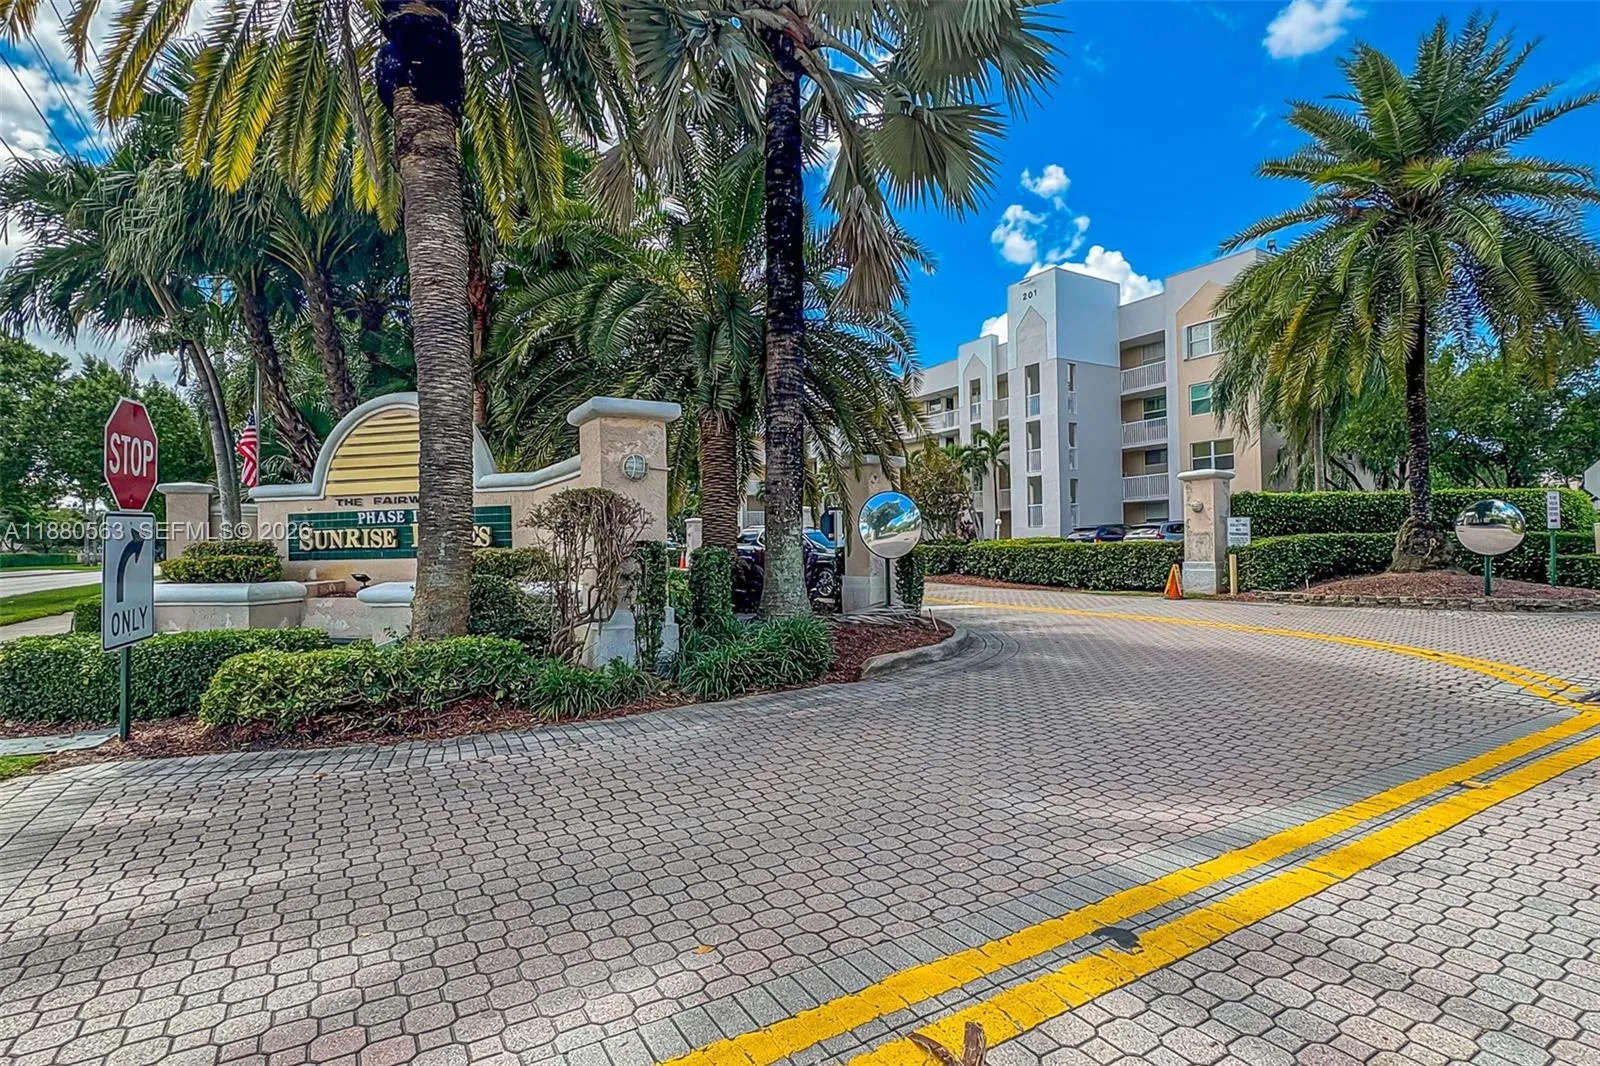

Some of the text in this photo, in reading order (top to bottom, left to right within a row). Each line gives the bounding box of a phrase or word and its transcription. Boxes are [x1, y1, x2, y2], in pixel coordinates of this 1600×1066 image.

[1022, 289, 1037, 301] 201
[109, 432, 154, 477] STOP
[335, 495, 420, 507] THE FAIRW
[357, 510, 406, 525] PHASE
[299, 527, 397, 550] SUNRISE
[111, 605, 148, 637] ONLY
